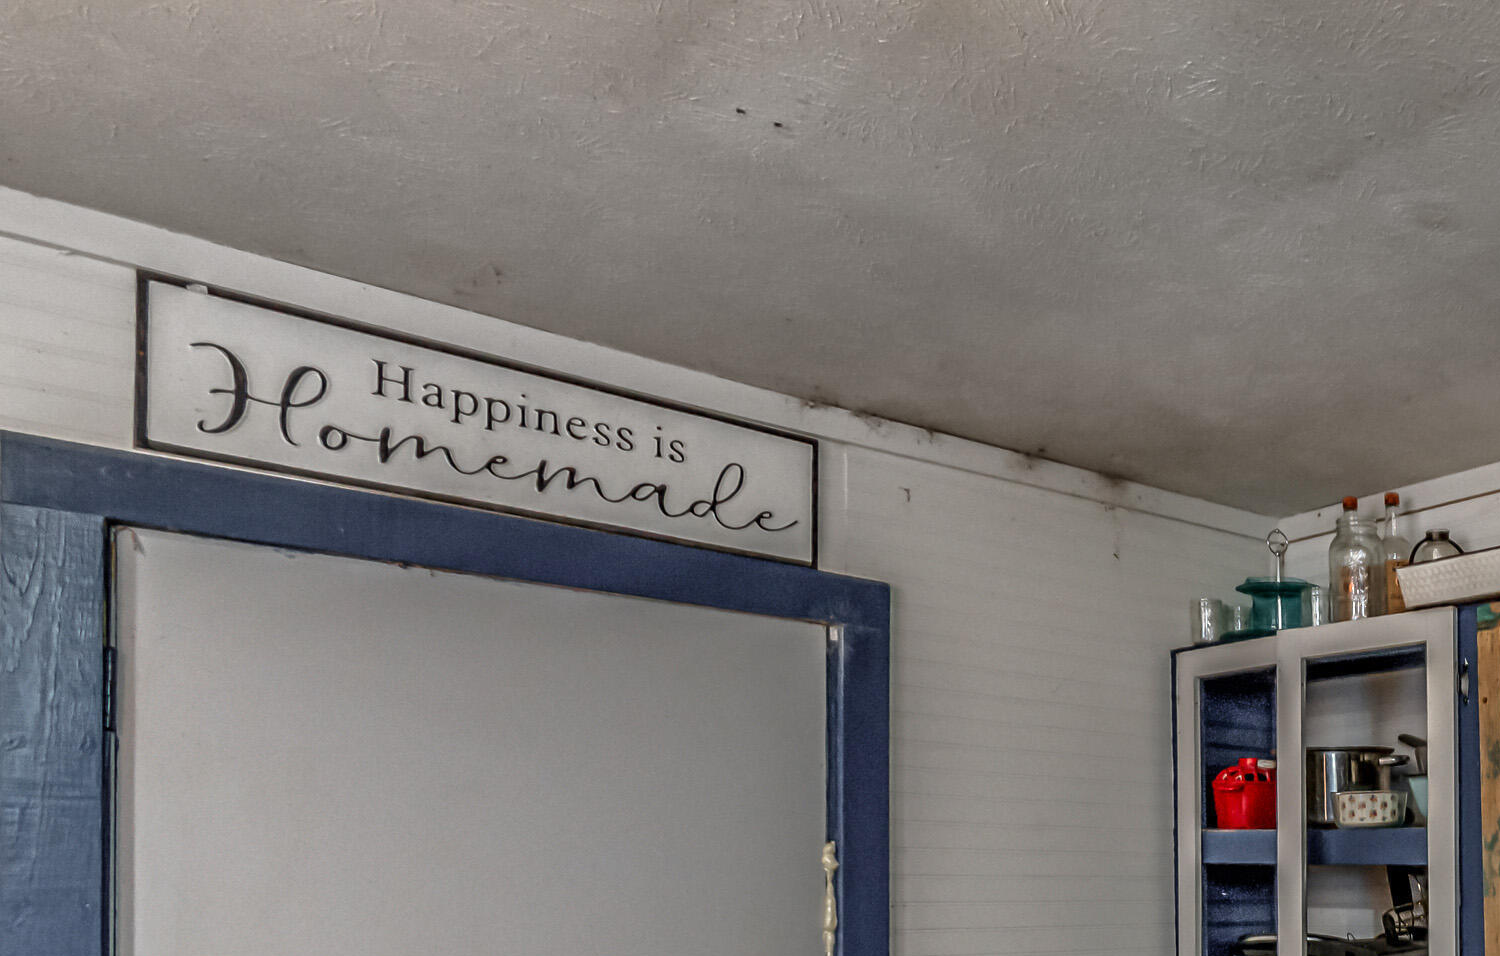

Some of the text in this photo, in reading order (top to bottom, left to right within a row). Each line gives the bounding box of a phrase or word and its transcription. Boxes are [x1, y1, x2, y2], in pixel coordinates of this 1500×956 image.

[189, 342, 798, 532] Homemade
[371, 359, 688, 463] Happiness is
